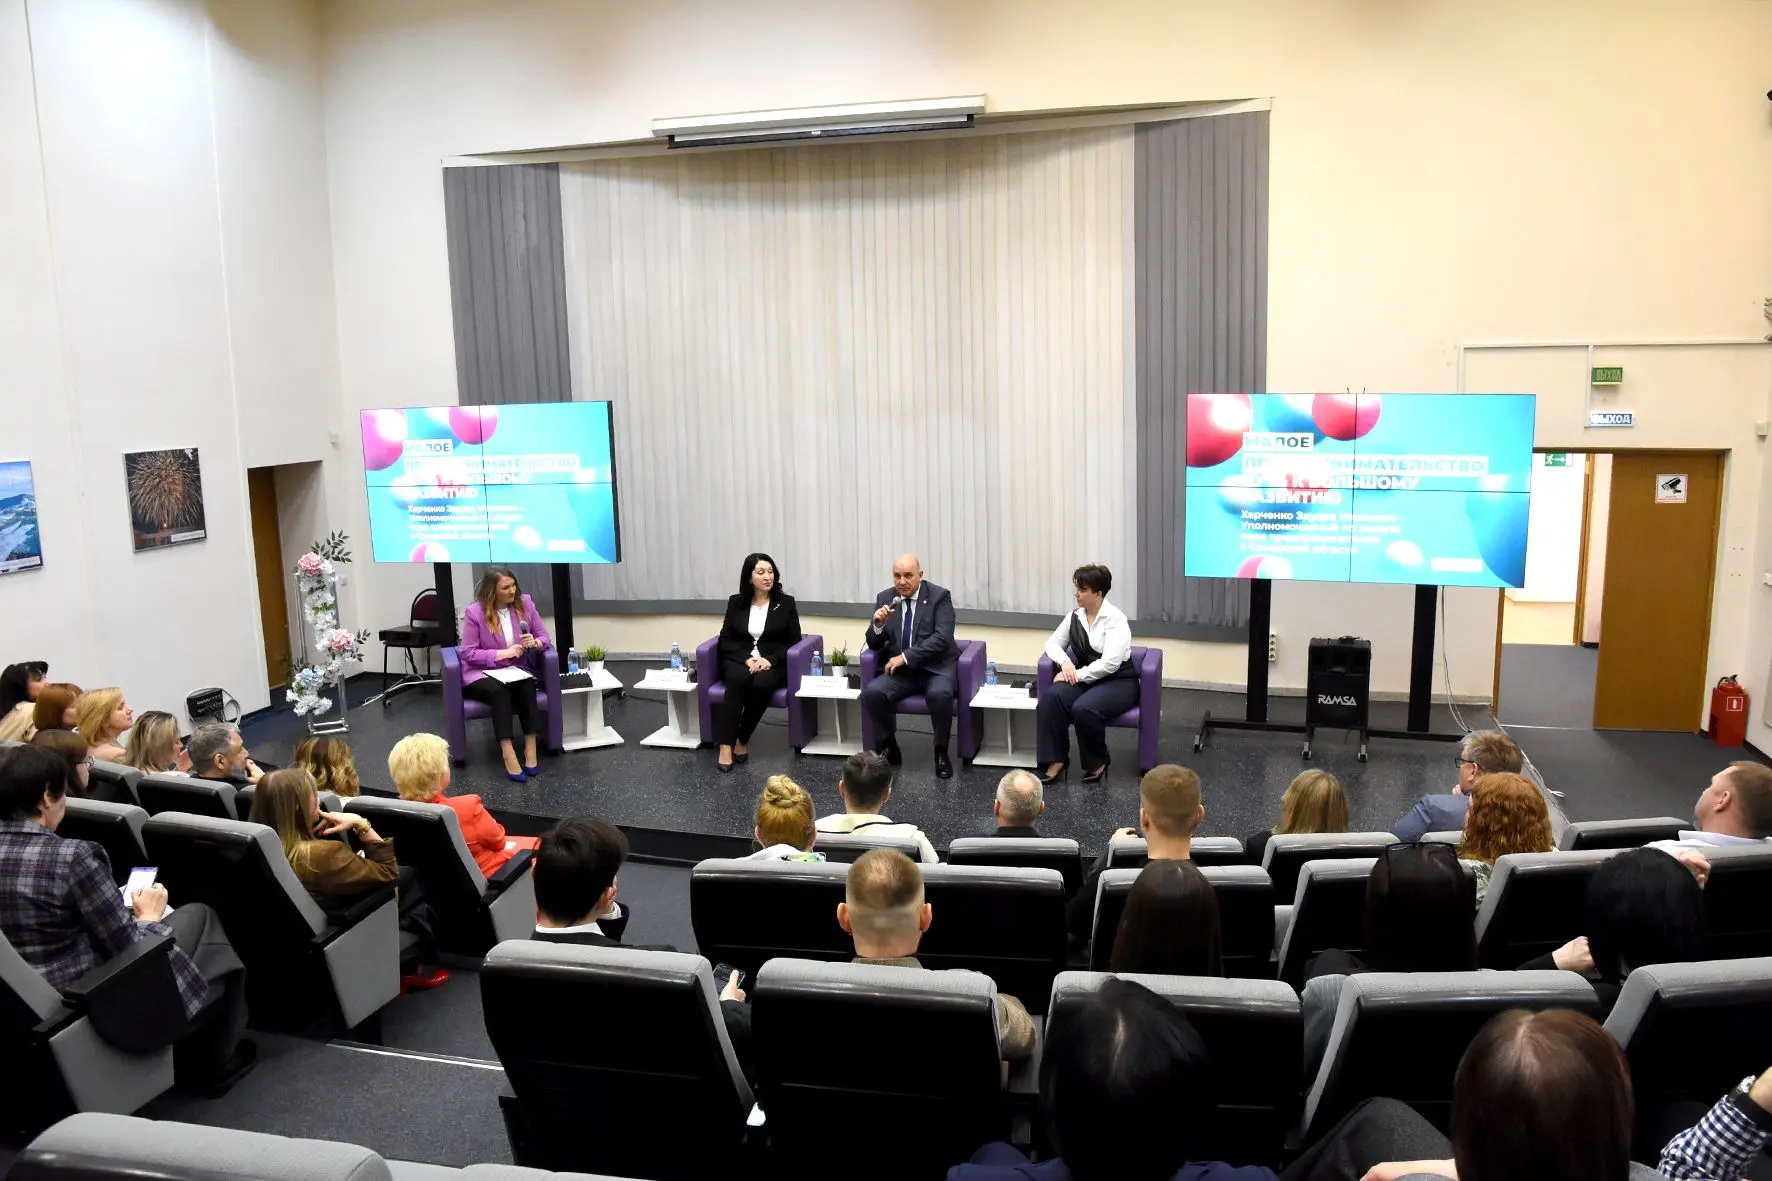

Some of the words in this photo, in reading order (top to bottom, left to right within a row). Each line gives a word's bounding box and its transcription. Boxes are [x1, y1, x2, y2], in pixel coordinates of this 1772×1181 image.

[1595, 368, 1622, 381] ВЫХОД
[1592, 414, 1631, 424] ЫХОД
[404, 442, 450, 452] МЛОЕ
[1245, 457, 1484, 472] ПРНИМАТЕЛЬСТВО
[1318, 694, 1357, 706] RAMSA
